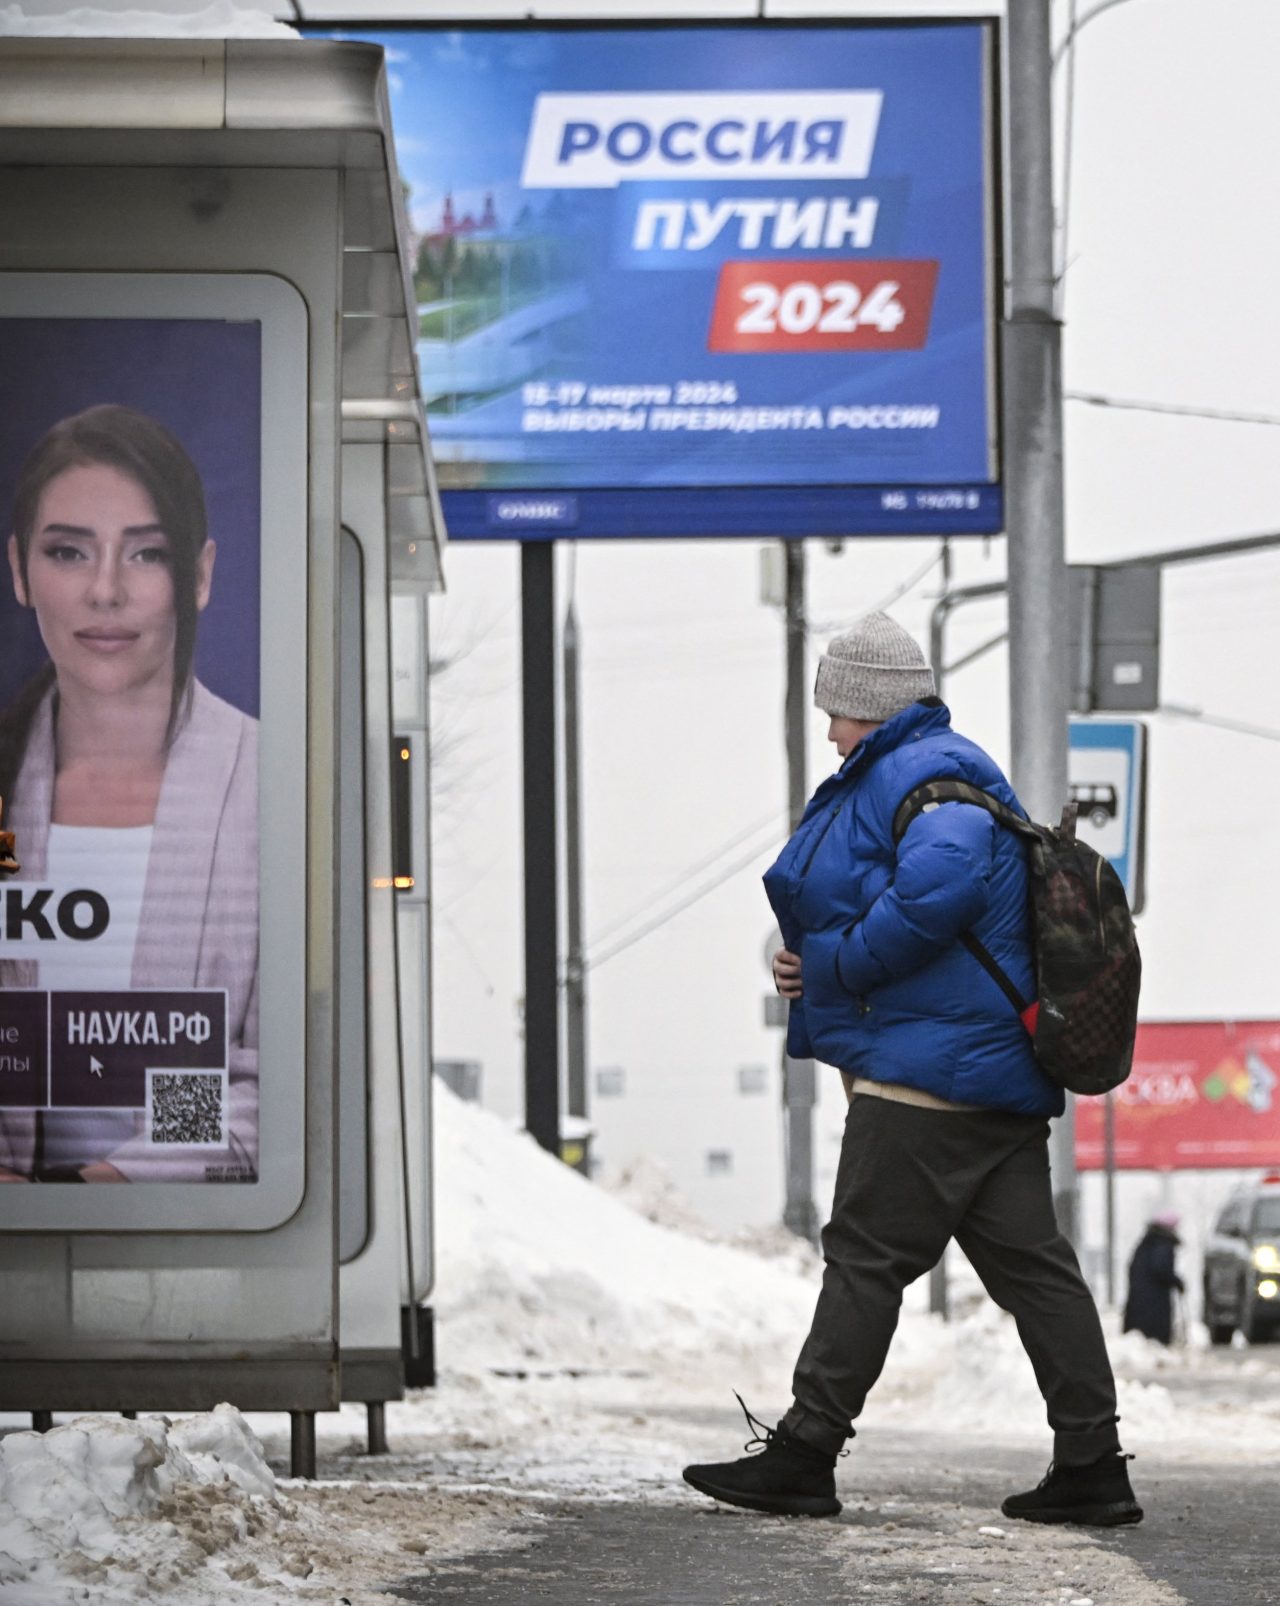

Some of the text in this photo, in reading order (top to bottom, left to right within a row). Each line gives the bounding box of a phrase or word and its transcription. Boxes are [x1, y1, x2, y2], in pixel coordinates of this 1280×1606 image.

[558, 119, 846, 167] РОССИЯ
[631, 197, 879, 250] ПУТИН
[735, 280, 904, 335] 2024
[587, 385, 672, 409] марта
[674, 380, 738, 405] 2024
[521, 405, 940, 433] ВЫБОРЫ ПРЕЗИДЕНТА РОССИИ
[0, 888, 110, 942] КО
[67, 1011, 211, 1045] НАУКА.РФ
